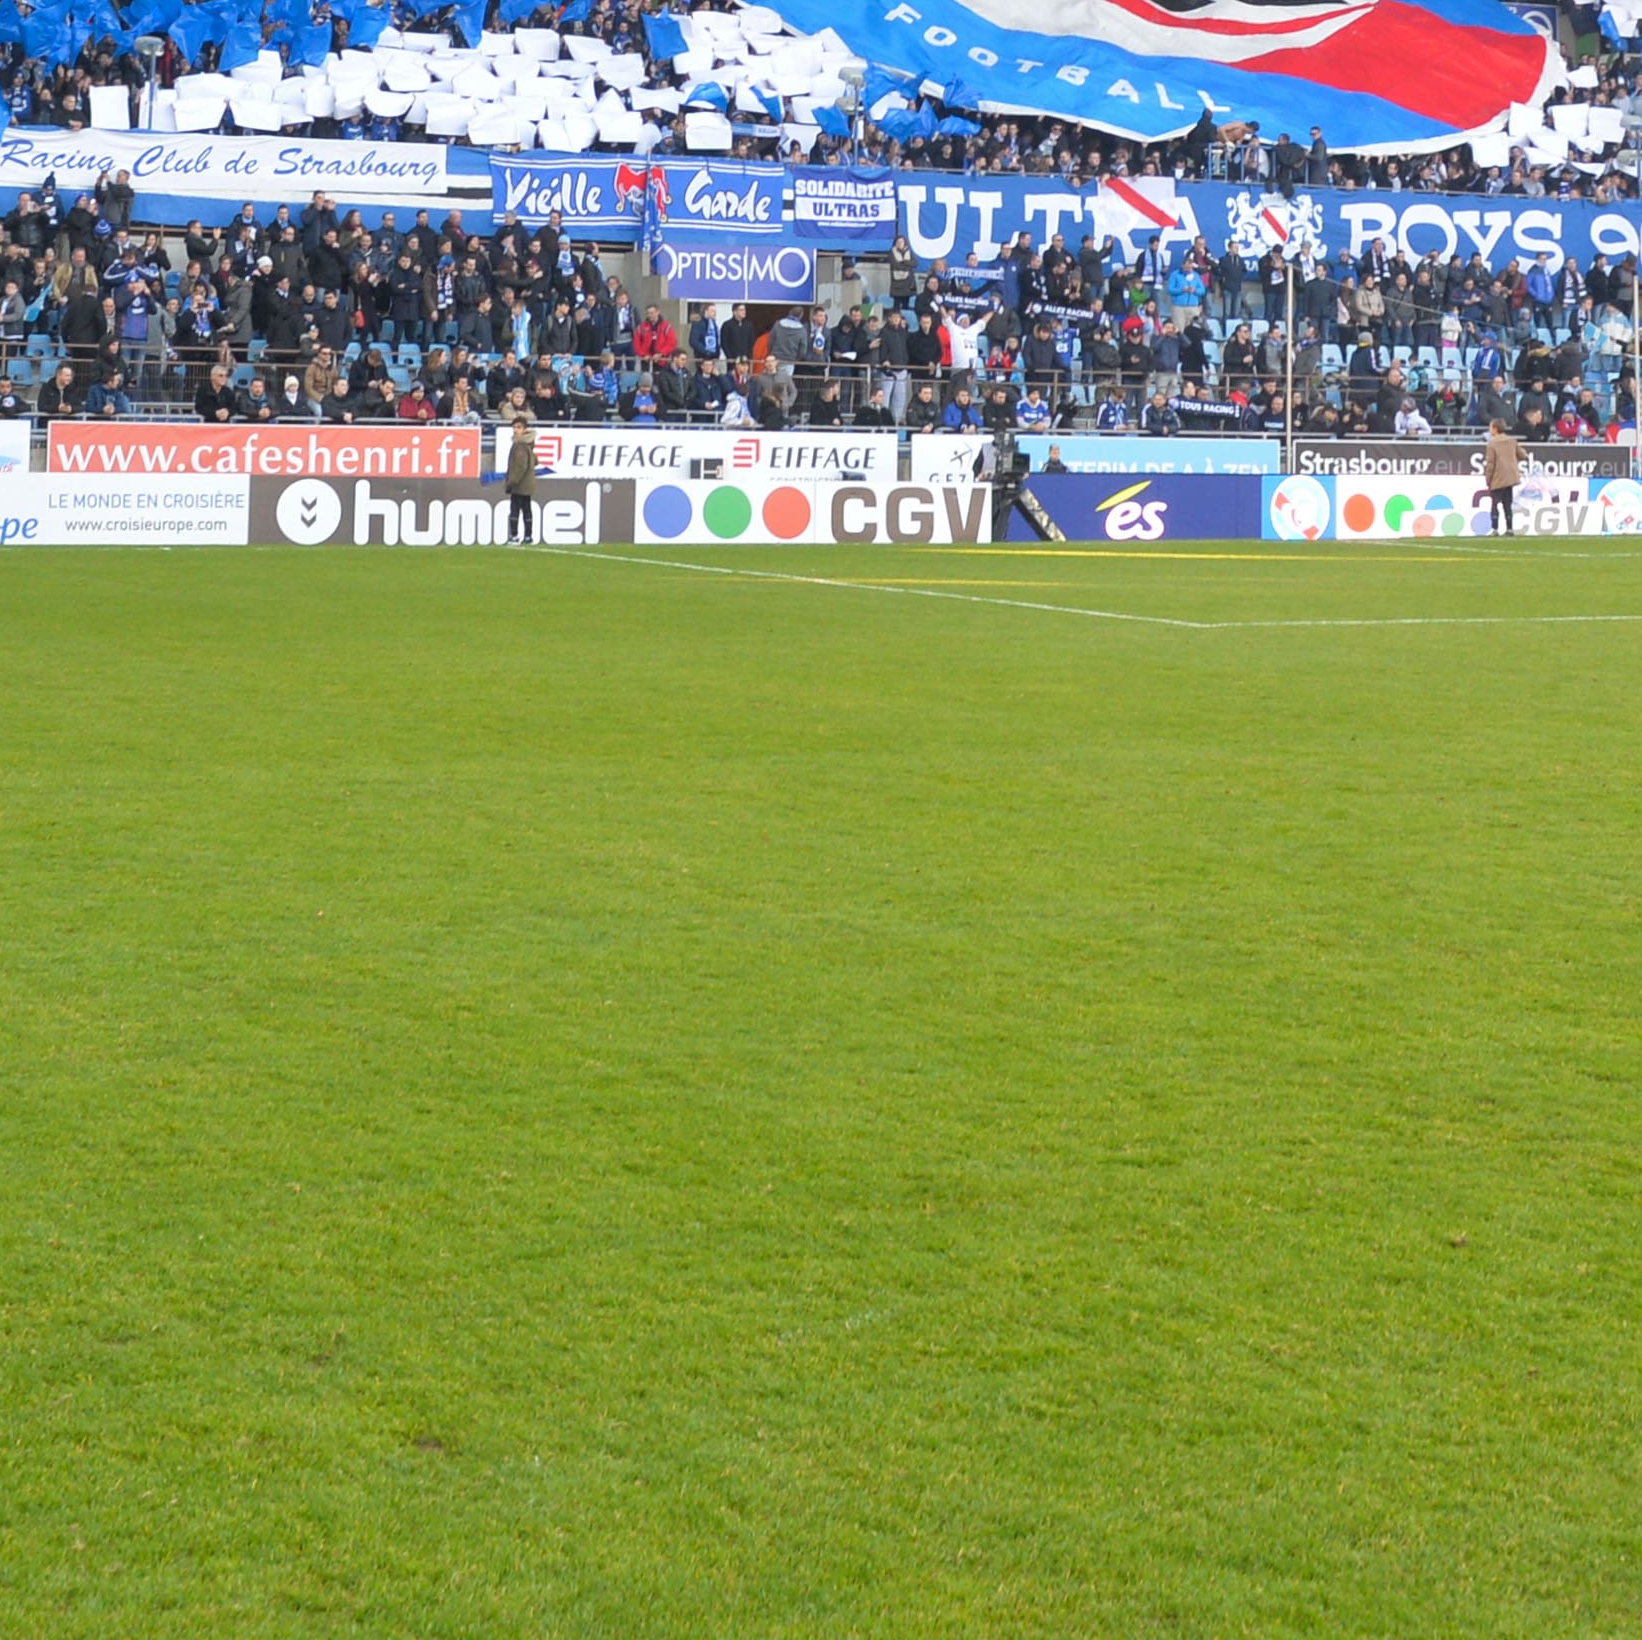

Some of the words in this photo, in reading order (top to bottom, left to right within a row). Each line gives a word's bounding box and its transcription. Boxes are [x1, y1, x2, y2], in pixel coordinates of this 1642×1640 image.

[884, 2, 1231, 112] FOOTBALL
[0, 139, 114, 174] Racing
[133, 146, 212, 177] Club
[224, 148, 259, 176] de
[273, 145, 441, 186] Strasbourg
[504, 167, 602, 216] Vieille
[685, 166, 772, 223] Garde
[813, 202, 880, 218] ULTRAS
[1340, 202, 1564, 276] BOYS
[1180, 401, 1202, 412] TOUS
[1204, 403, 1234, 415] RACING
[57, 432, 470, 476] www.cafeshenri.fr
[572, 445, 683, 468] EIFFAGE
[770, 447, 877, 469] EIFFAGE
[48, 493, 69, 509] LE
[73, 493, 132, 509] MONDE
[138, 493, 159, 509] EN
[162, 490, 244, 509] CROISIÈRE
[831, 487, 986, 543] CGV
[65, 517, 227, 534] www.croisieurope.com
